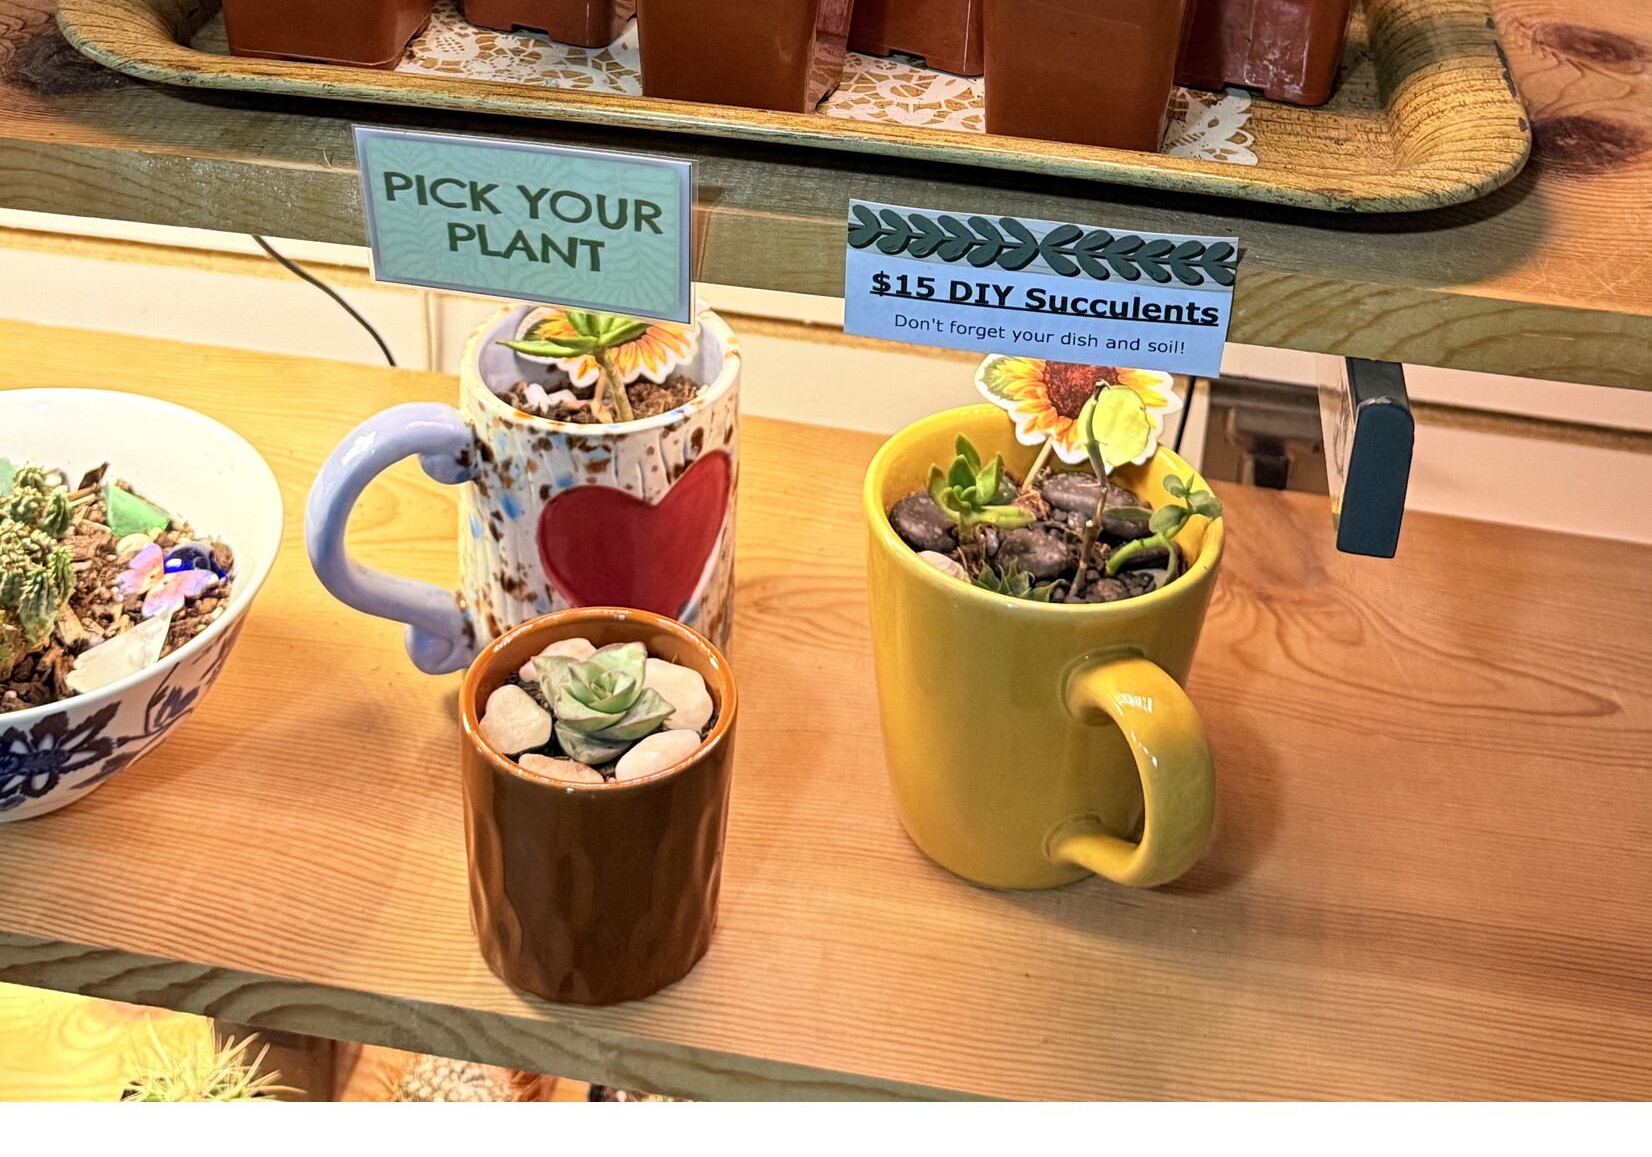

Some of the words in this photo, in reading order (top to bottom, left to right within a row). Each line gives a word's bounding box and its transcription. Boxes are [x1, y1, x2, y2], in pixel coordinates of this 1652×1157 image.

[384, 171, 502, 215] PICK
[517, 185, 663, 234] YOUR
[447, 222, 605, 272] PLANT
[871, 270, 935, 297] $15
[949, 280, 1014, 307] DIY
[1025, 287, 1219, 325] Succulents
[895, 314, 944, 333] Don't
[950, 321, 1006, 340] forget
[1012, 329, 1054, 344] your
[1061, 332, 1098, 348] dish
[1105, 337, 1140, 353] and
[1148, 340, 1185, 355] soil!
